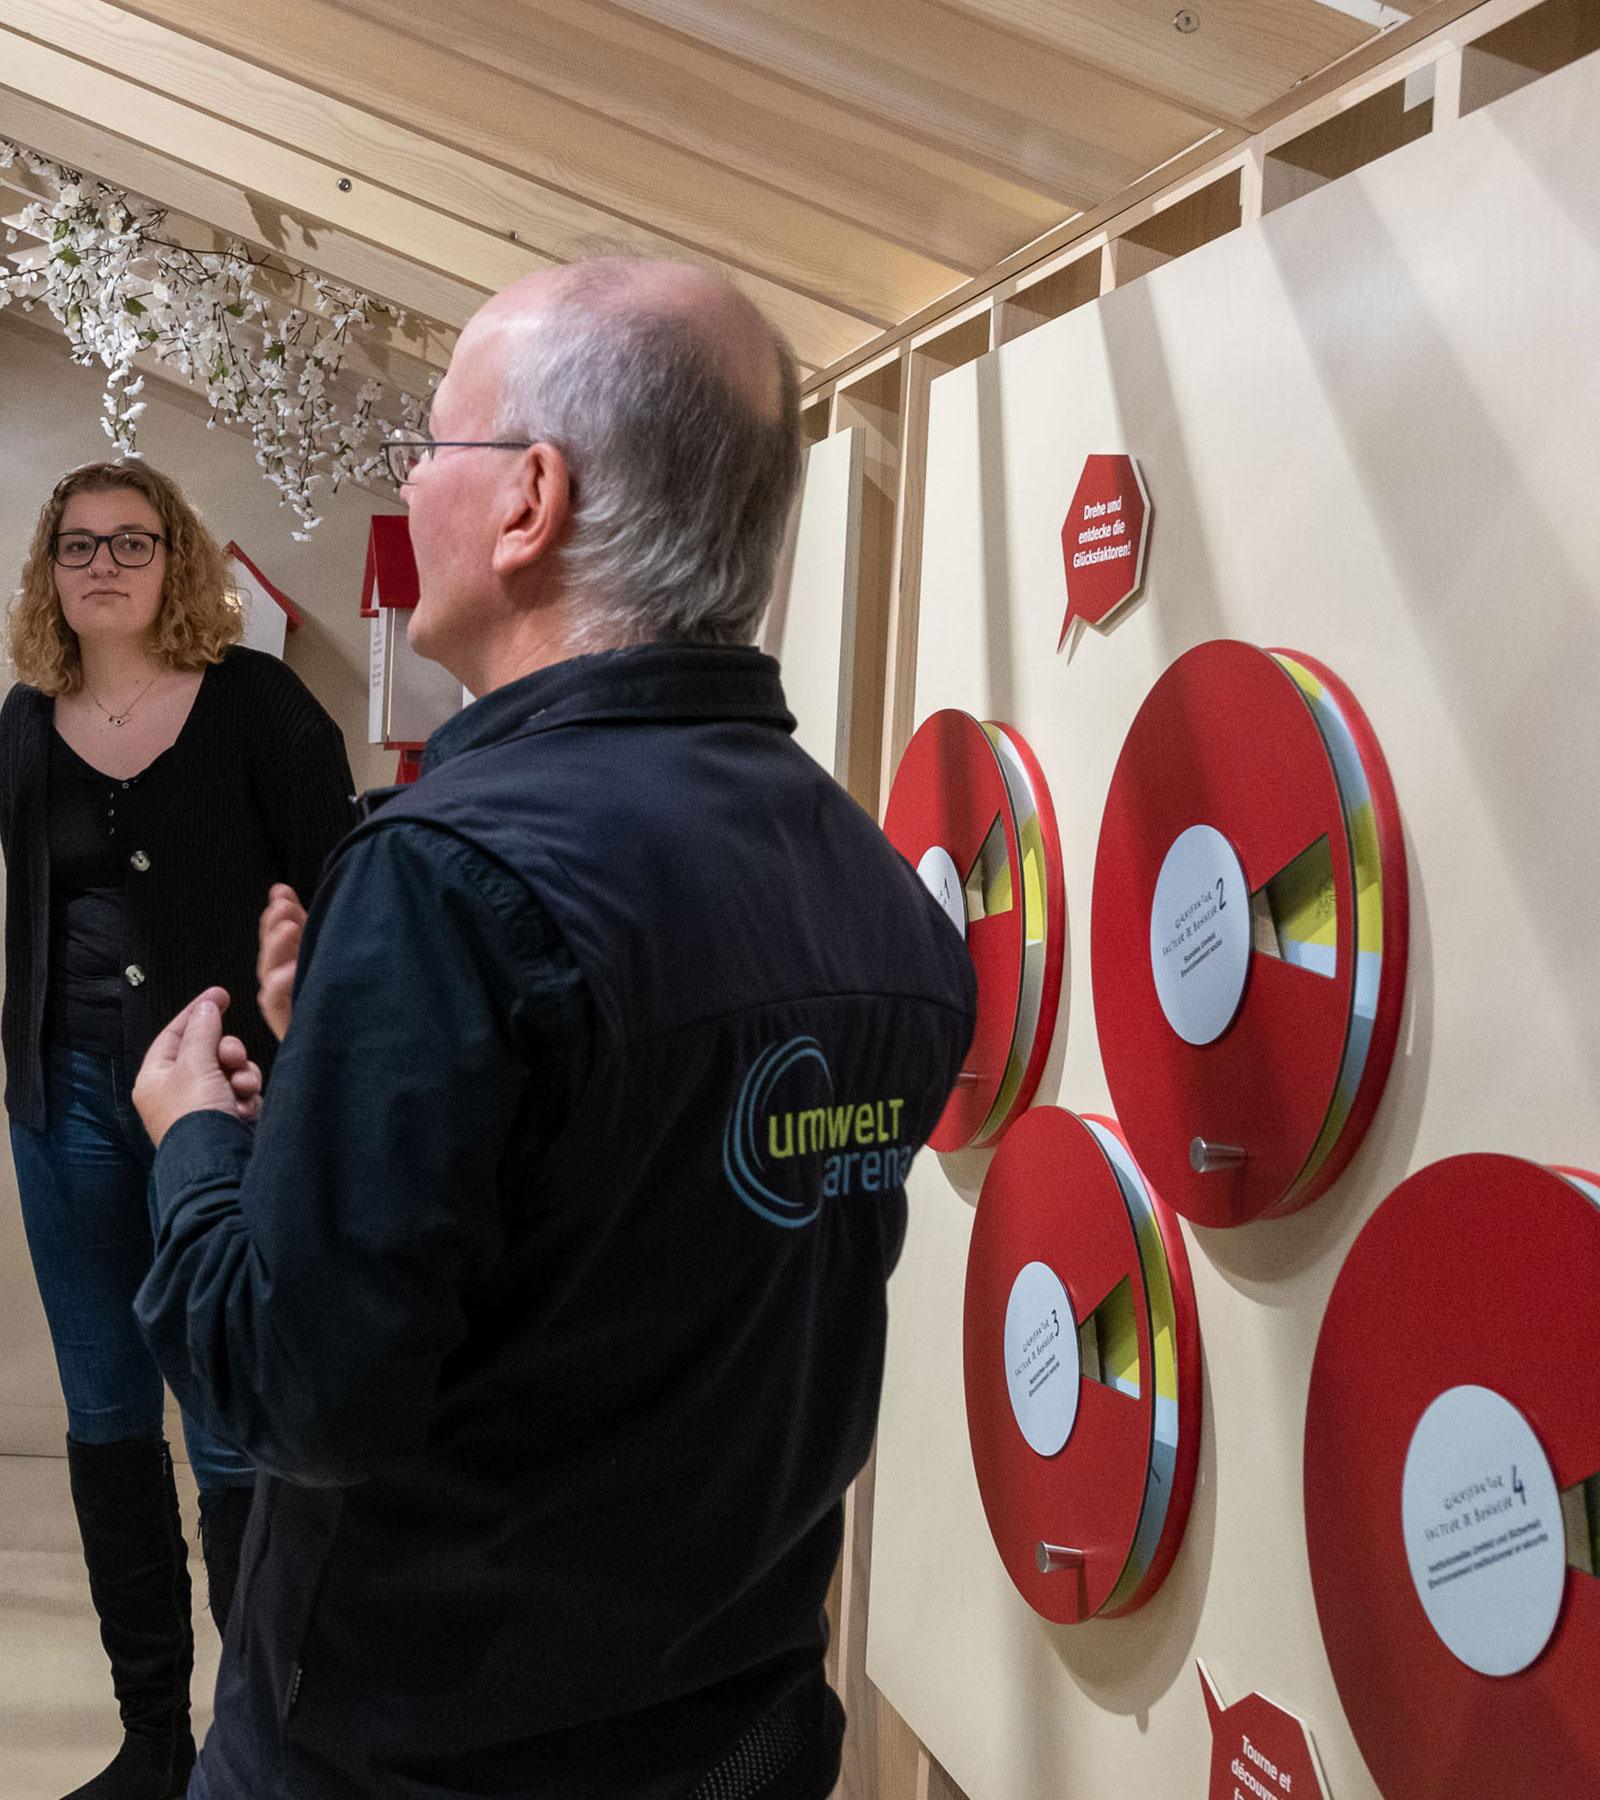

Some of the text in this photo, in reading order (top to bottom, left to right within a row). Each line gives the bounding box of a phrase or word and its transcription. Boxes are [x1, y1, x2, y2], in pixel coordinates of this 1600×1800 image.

[1084, 496, 1122, 520] Drehe und
[1078, 518, 1125, 545] entdecke die
[1073, 540, 1132, 569] Glücksfaktoren!
[1216, 877, 1227, 911] 2
[1051, 1308, 1060, 1337] 3
[1512, 1465, 1527, 1505] 4
[1242, 1734, 1278, 1781] Tourne
[1279, 1772, 1292, 1793] et
